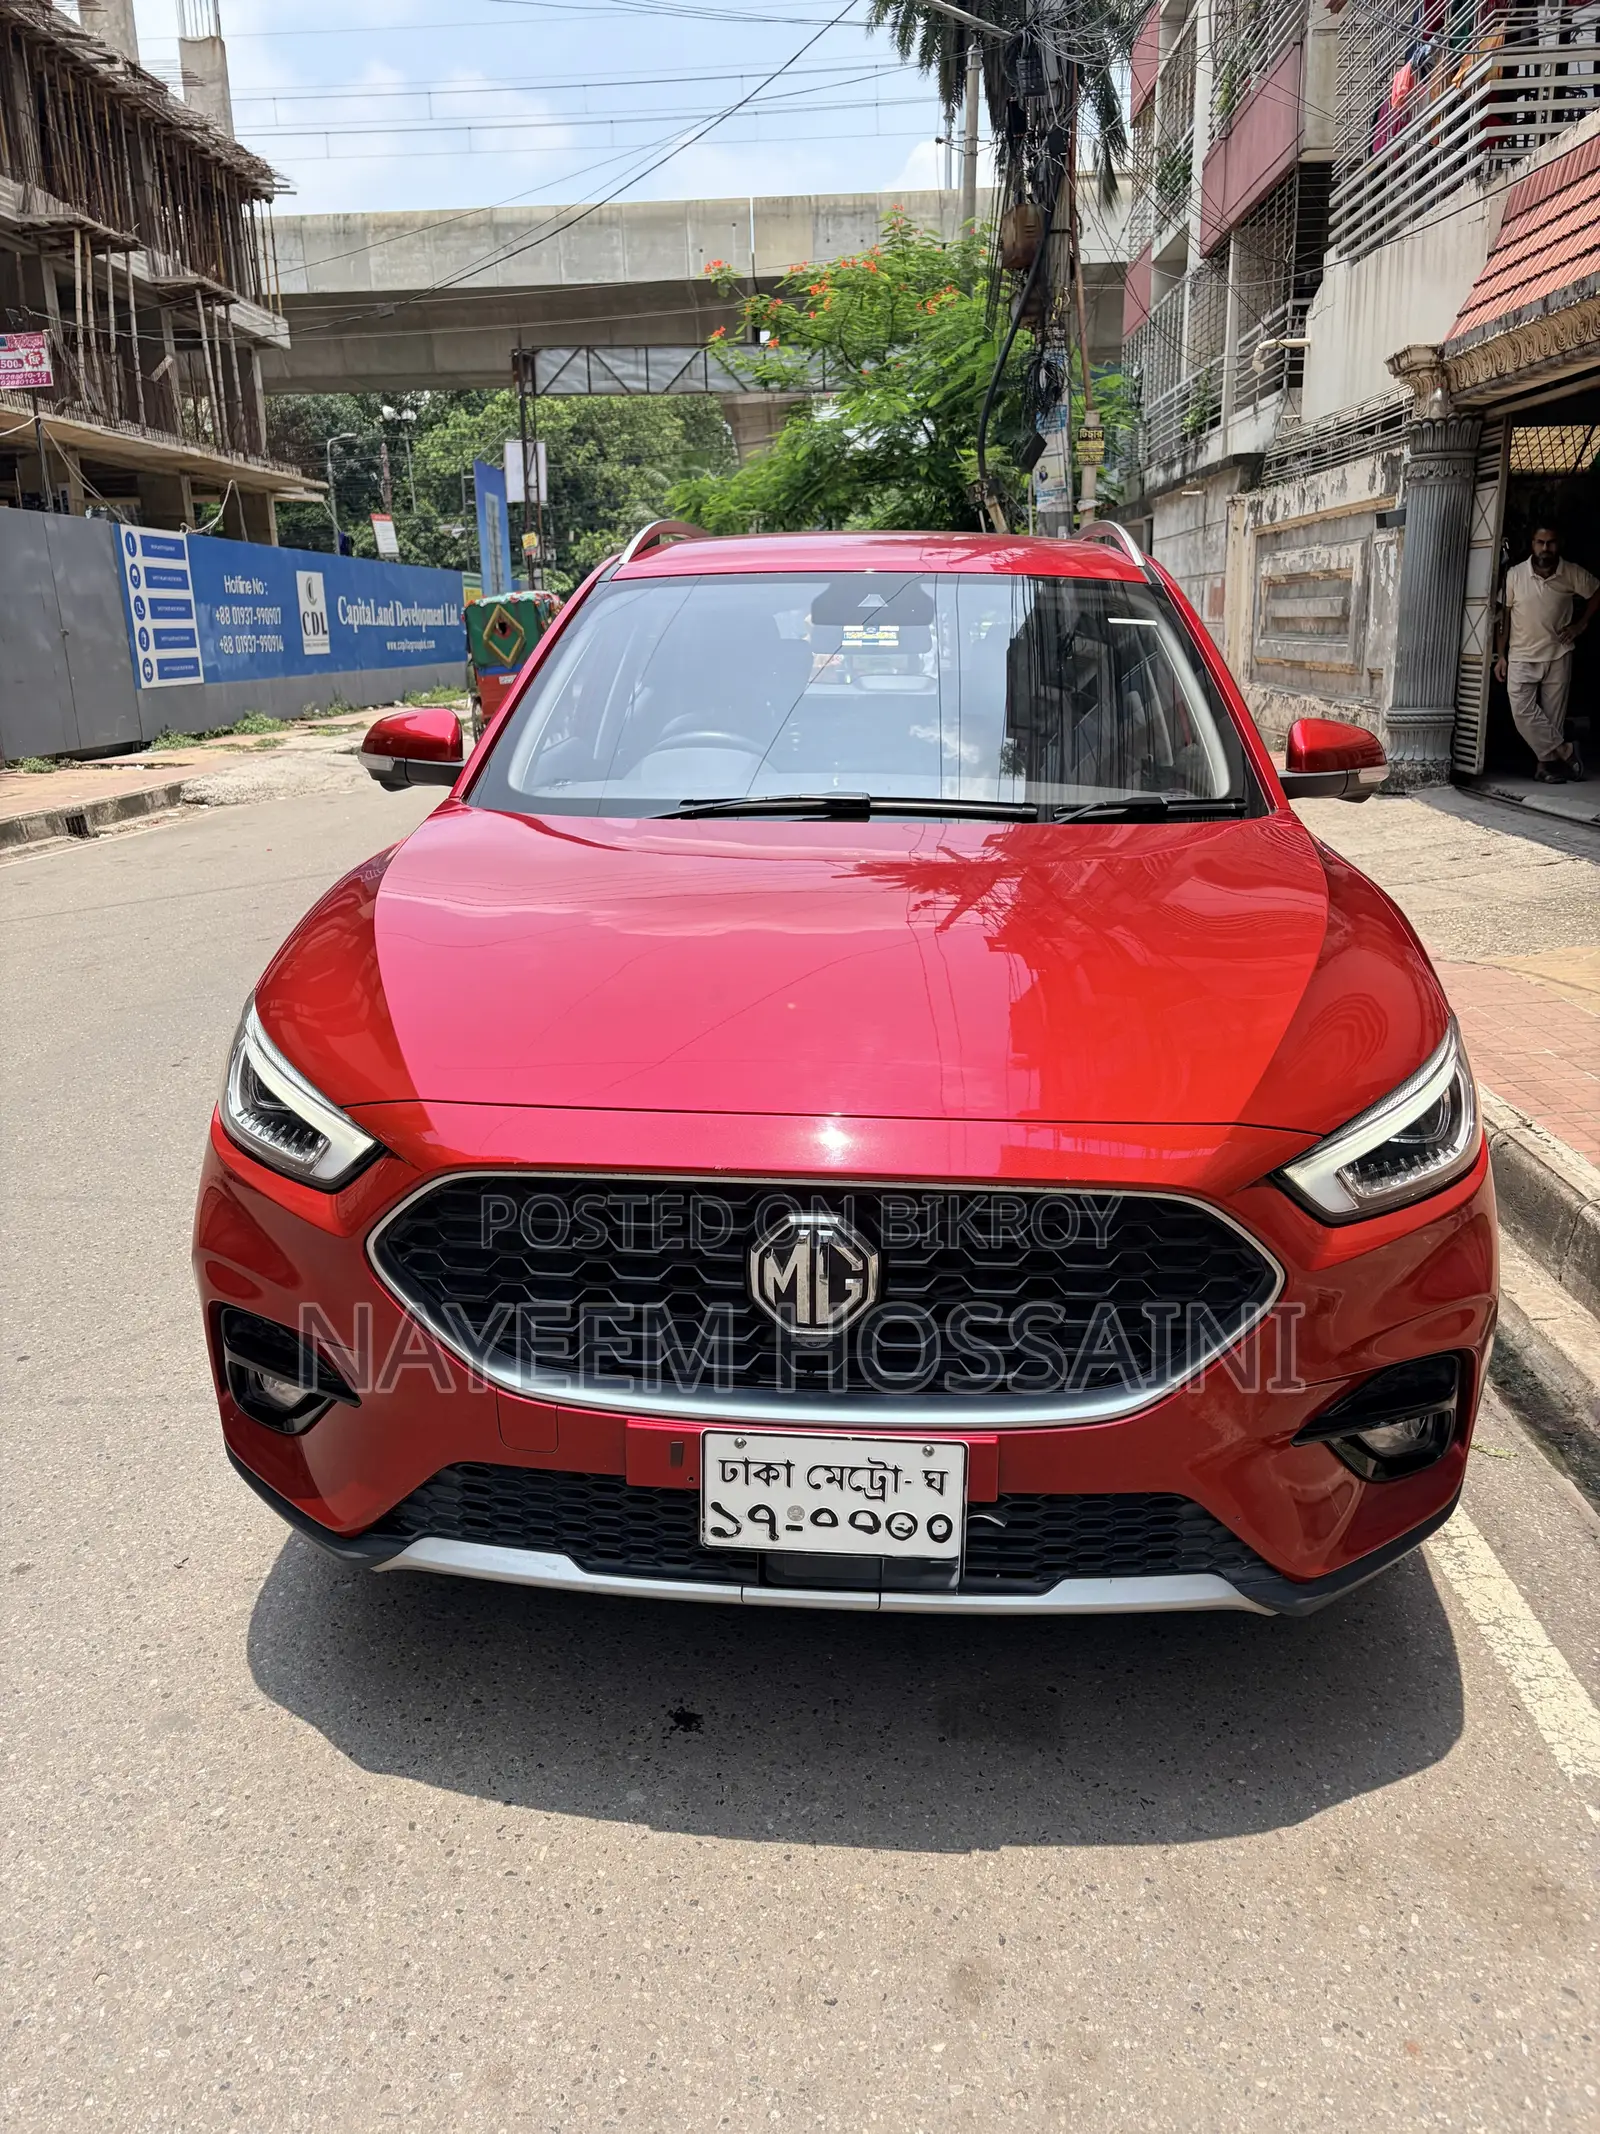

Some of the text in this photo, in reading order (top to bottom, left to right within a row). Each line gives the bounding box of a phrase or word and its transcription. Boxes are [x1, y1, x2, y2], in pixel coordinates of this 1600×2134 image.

[223, 575, 252, 594] Hotline
[215, 606, 231, 625] +88
[302, 611, 328, 636] CDL
[337, 596, 459, 633] CapitaLand Development Ltd.
[219, 635, 234, 654] +88
[763, 1229, 863, 1325] MG
[716, 1456, 795, 1489] ঢাকা
[920, 1468, 949, 1497] ঘ
